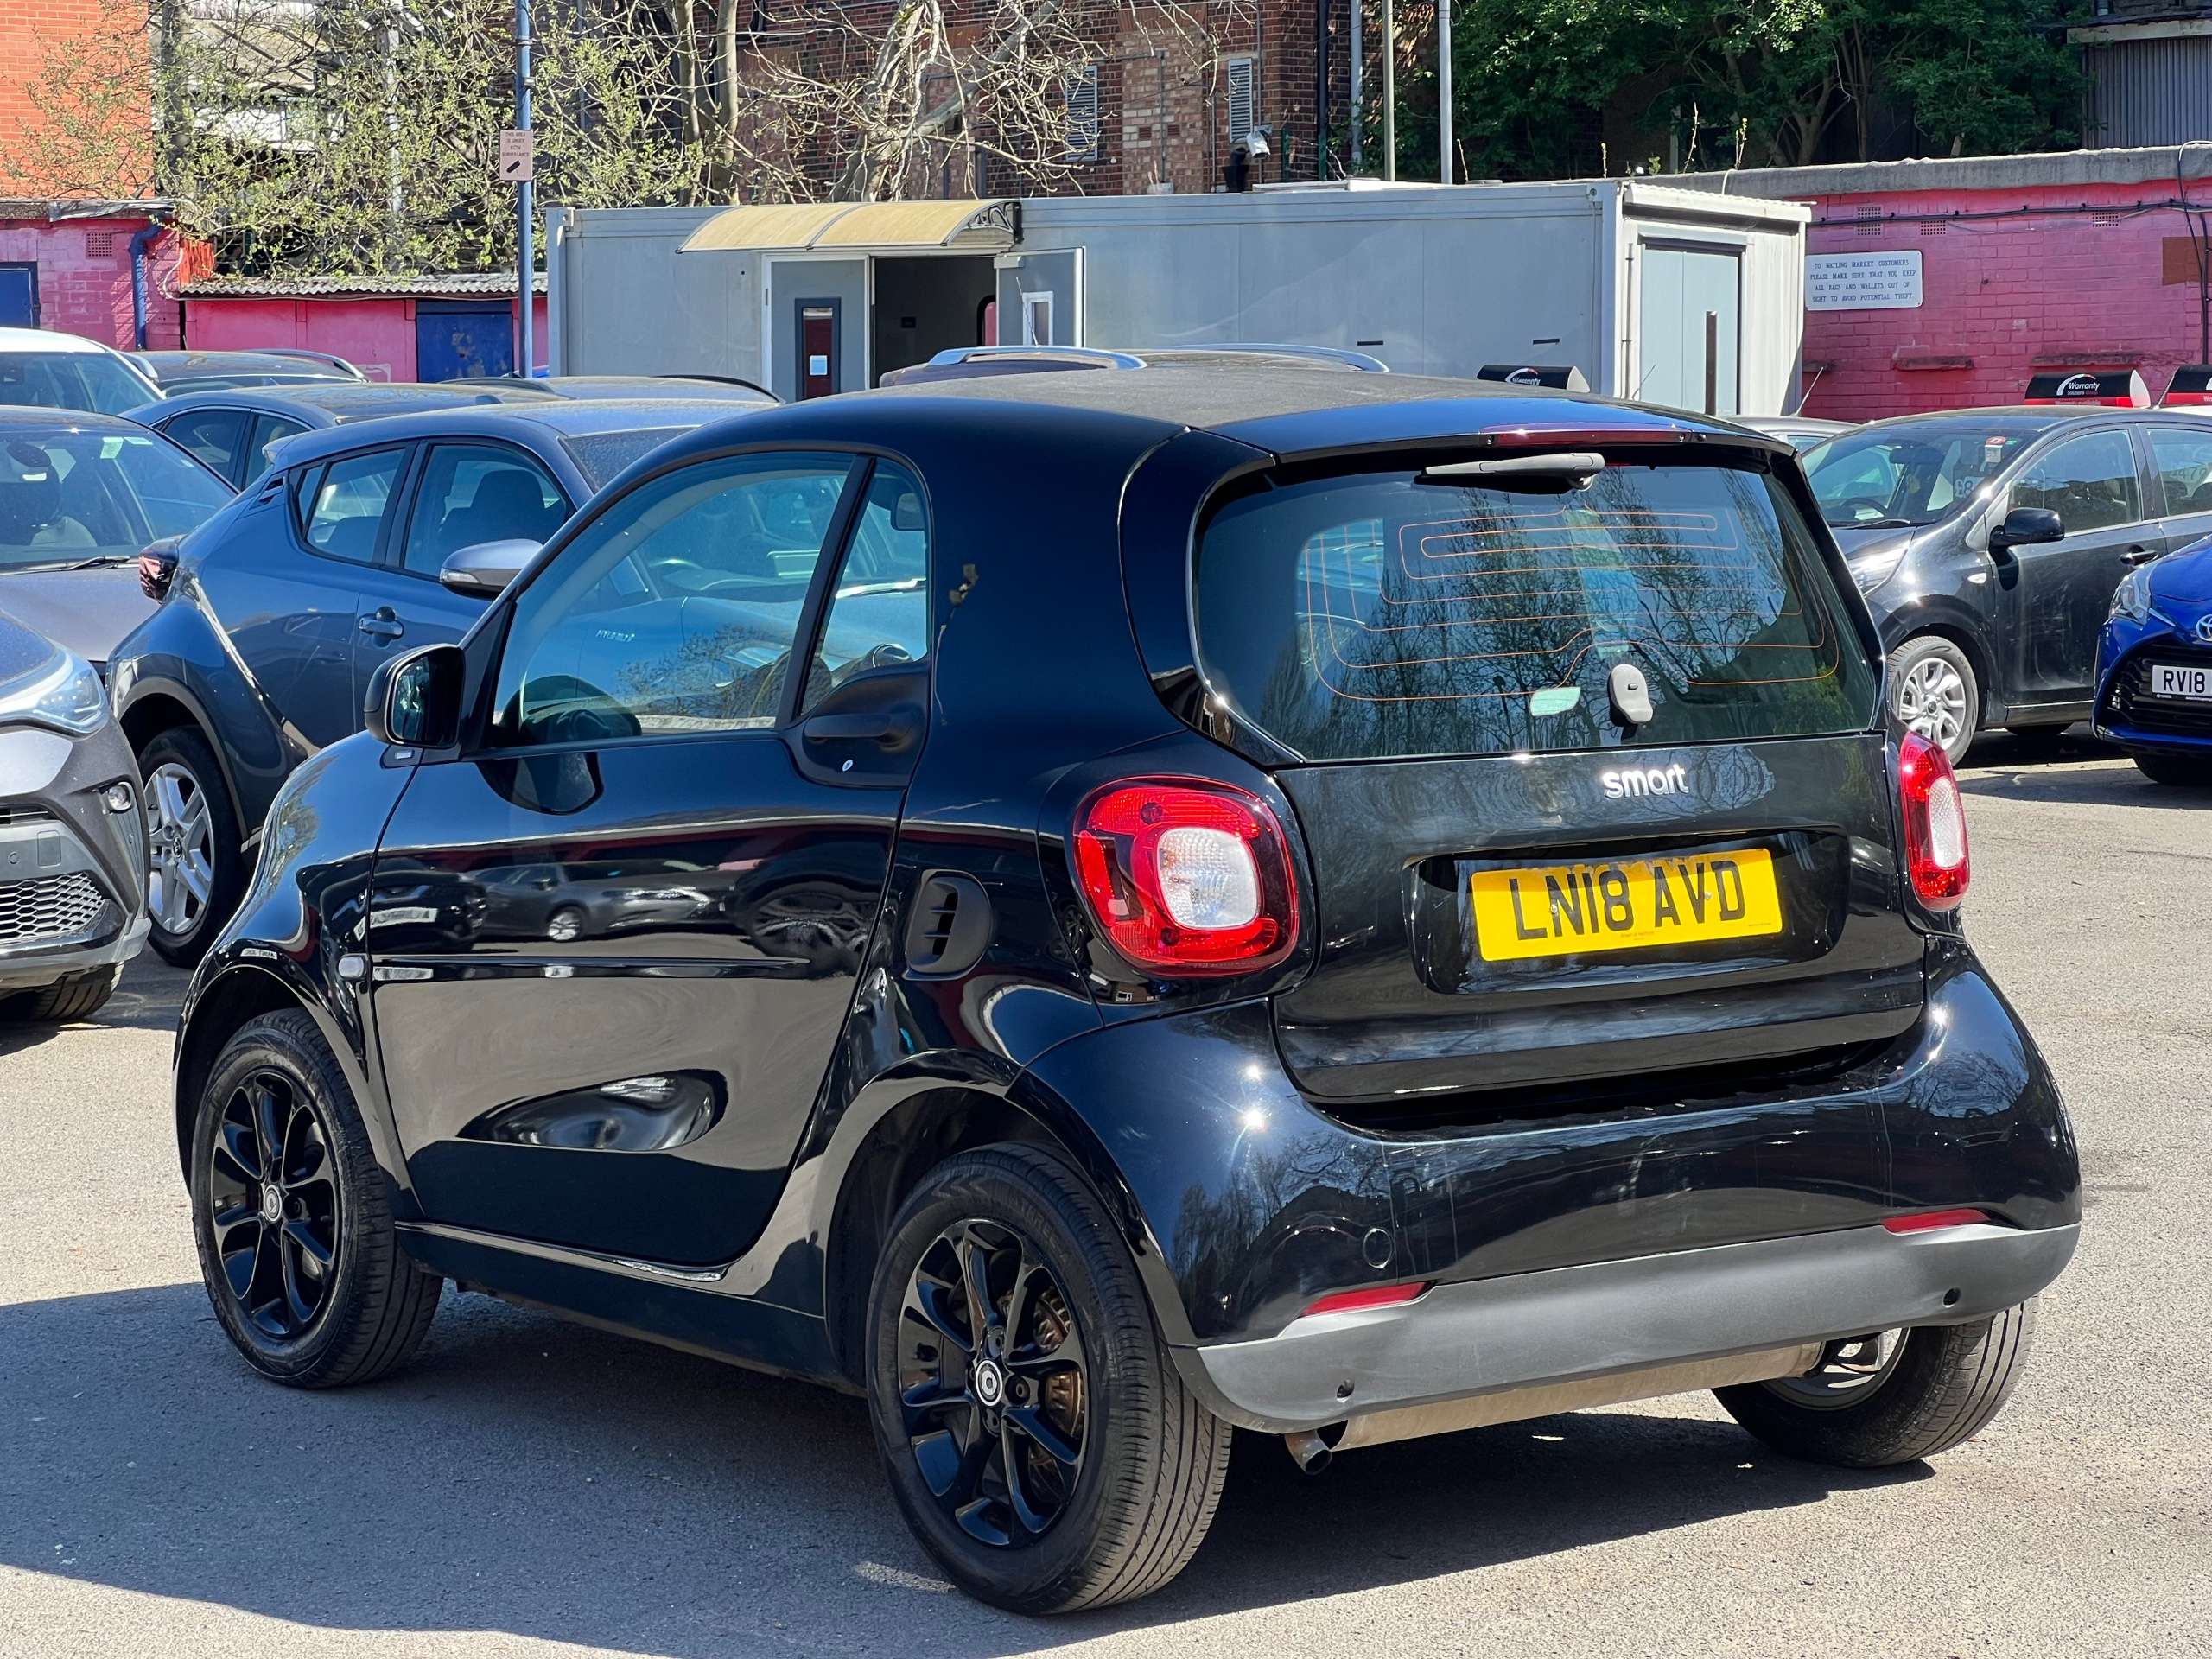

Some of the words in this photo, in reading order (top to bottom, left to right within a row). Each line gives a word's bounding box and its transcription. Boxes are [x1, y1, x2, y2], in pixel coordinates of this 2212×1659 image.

[2069, 382, 2100, 391] Warranty
[2164, 670, 2205, 693] RV18
[1603, 764, 1690, 799] smart
[1509, 869, 1634, 941] LN18
[1654, 860, 1747, 928] AVD
